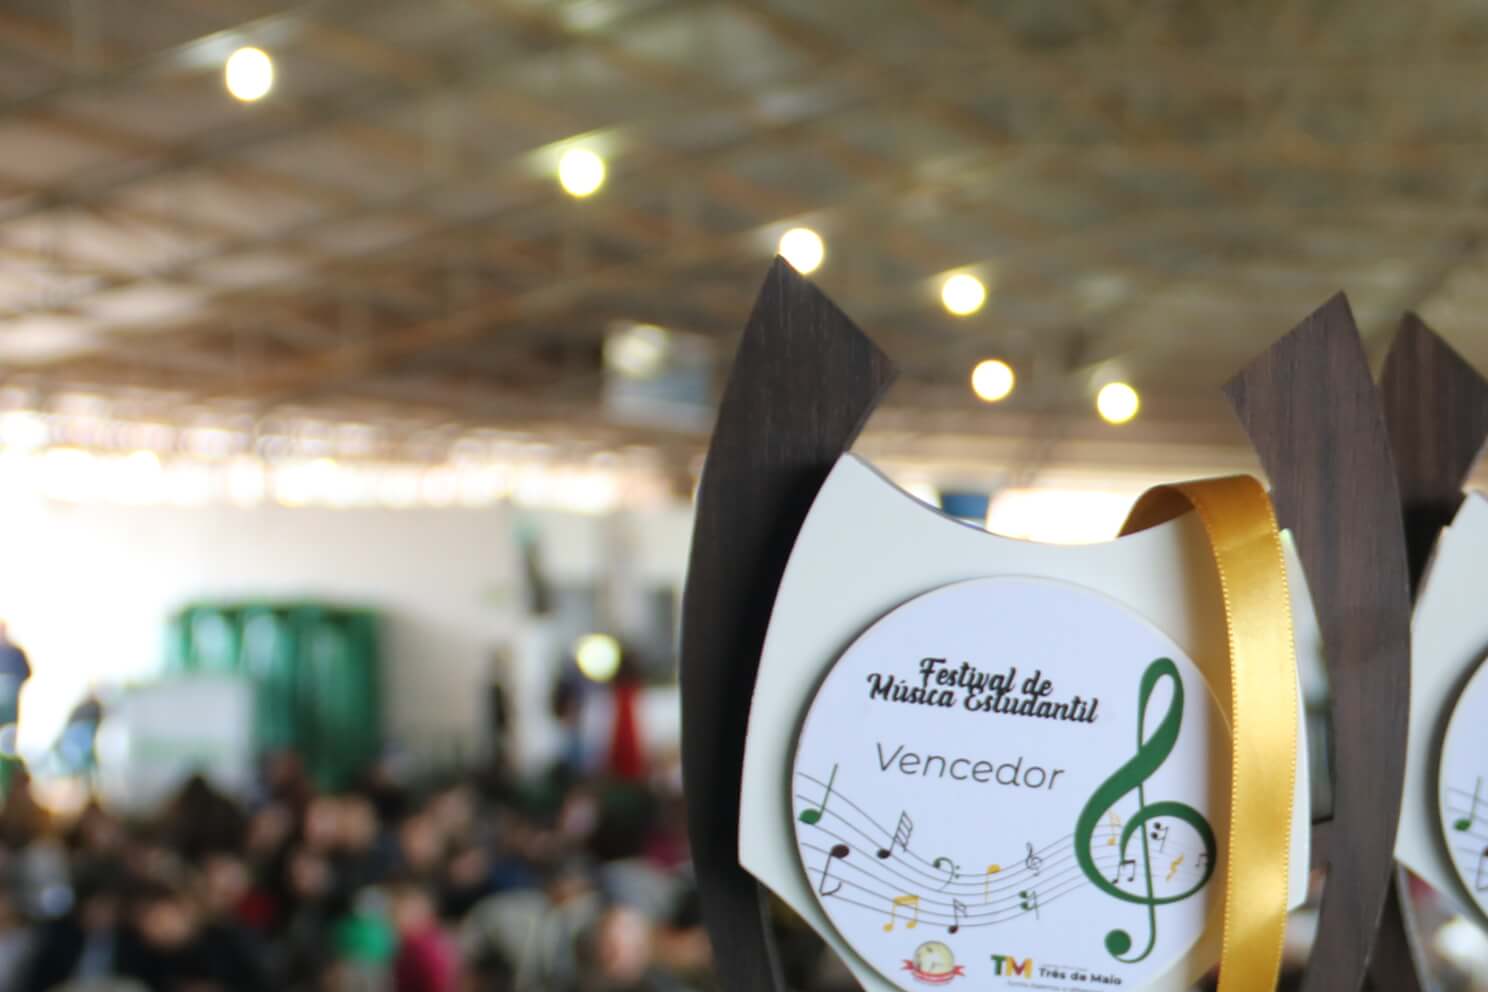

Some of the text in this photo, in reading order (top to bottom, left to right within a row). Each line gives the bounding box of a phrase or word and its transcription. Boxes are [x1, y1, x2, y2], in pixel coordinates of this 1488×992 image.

[867, 673, 1099, 723] Música Estudantil
[919, 656, 1053, 697] Festival de
[875, 741, 1065, 790] Vencedor
[991, 953, 1033, 979] TM
